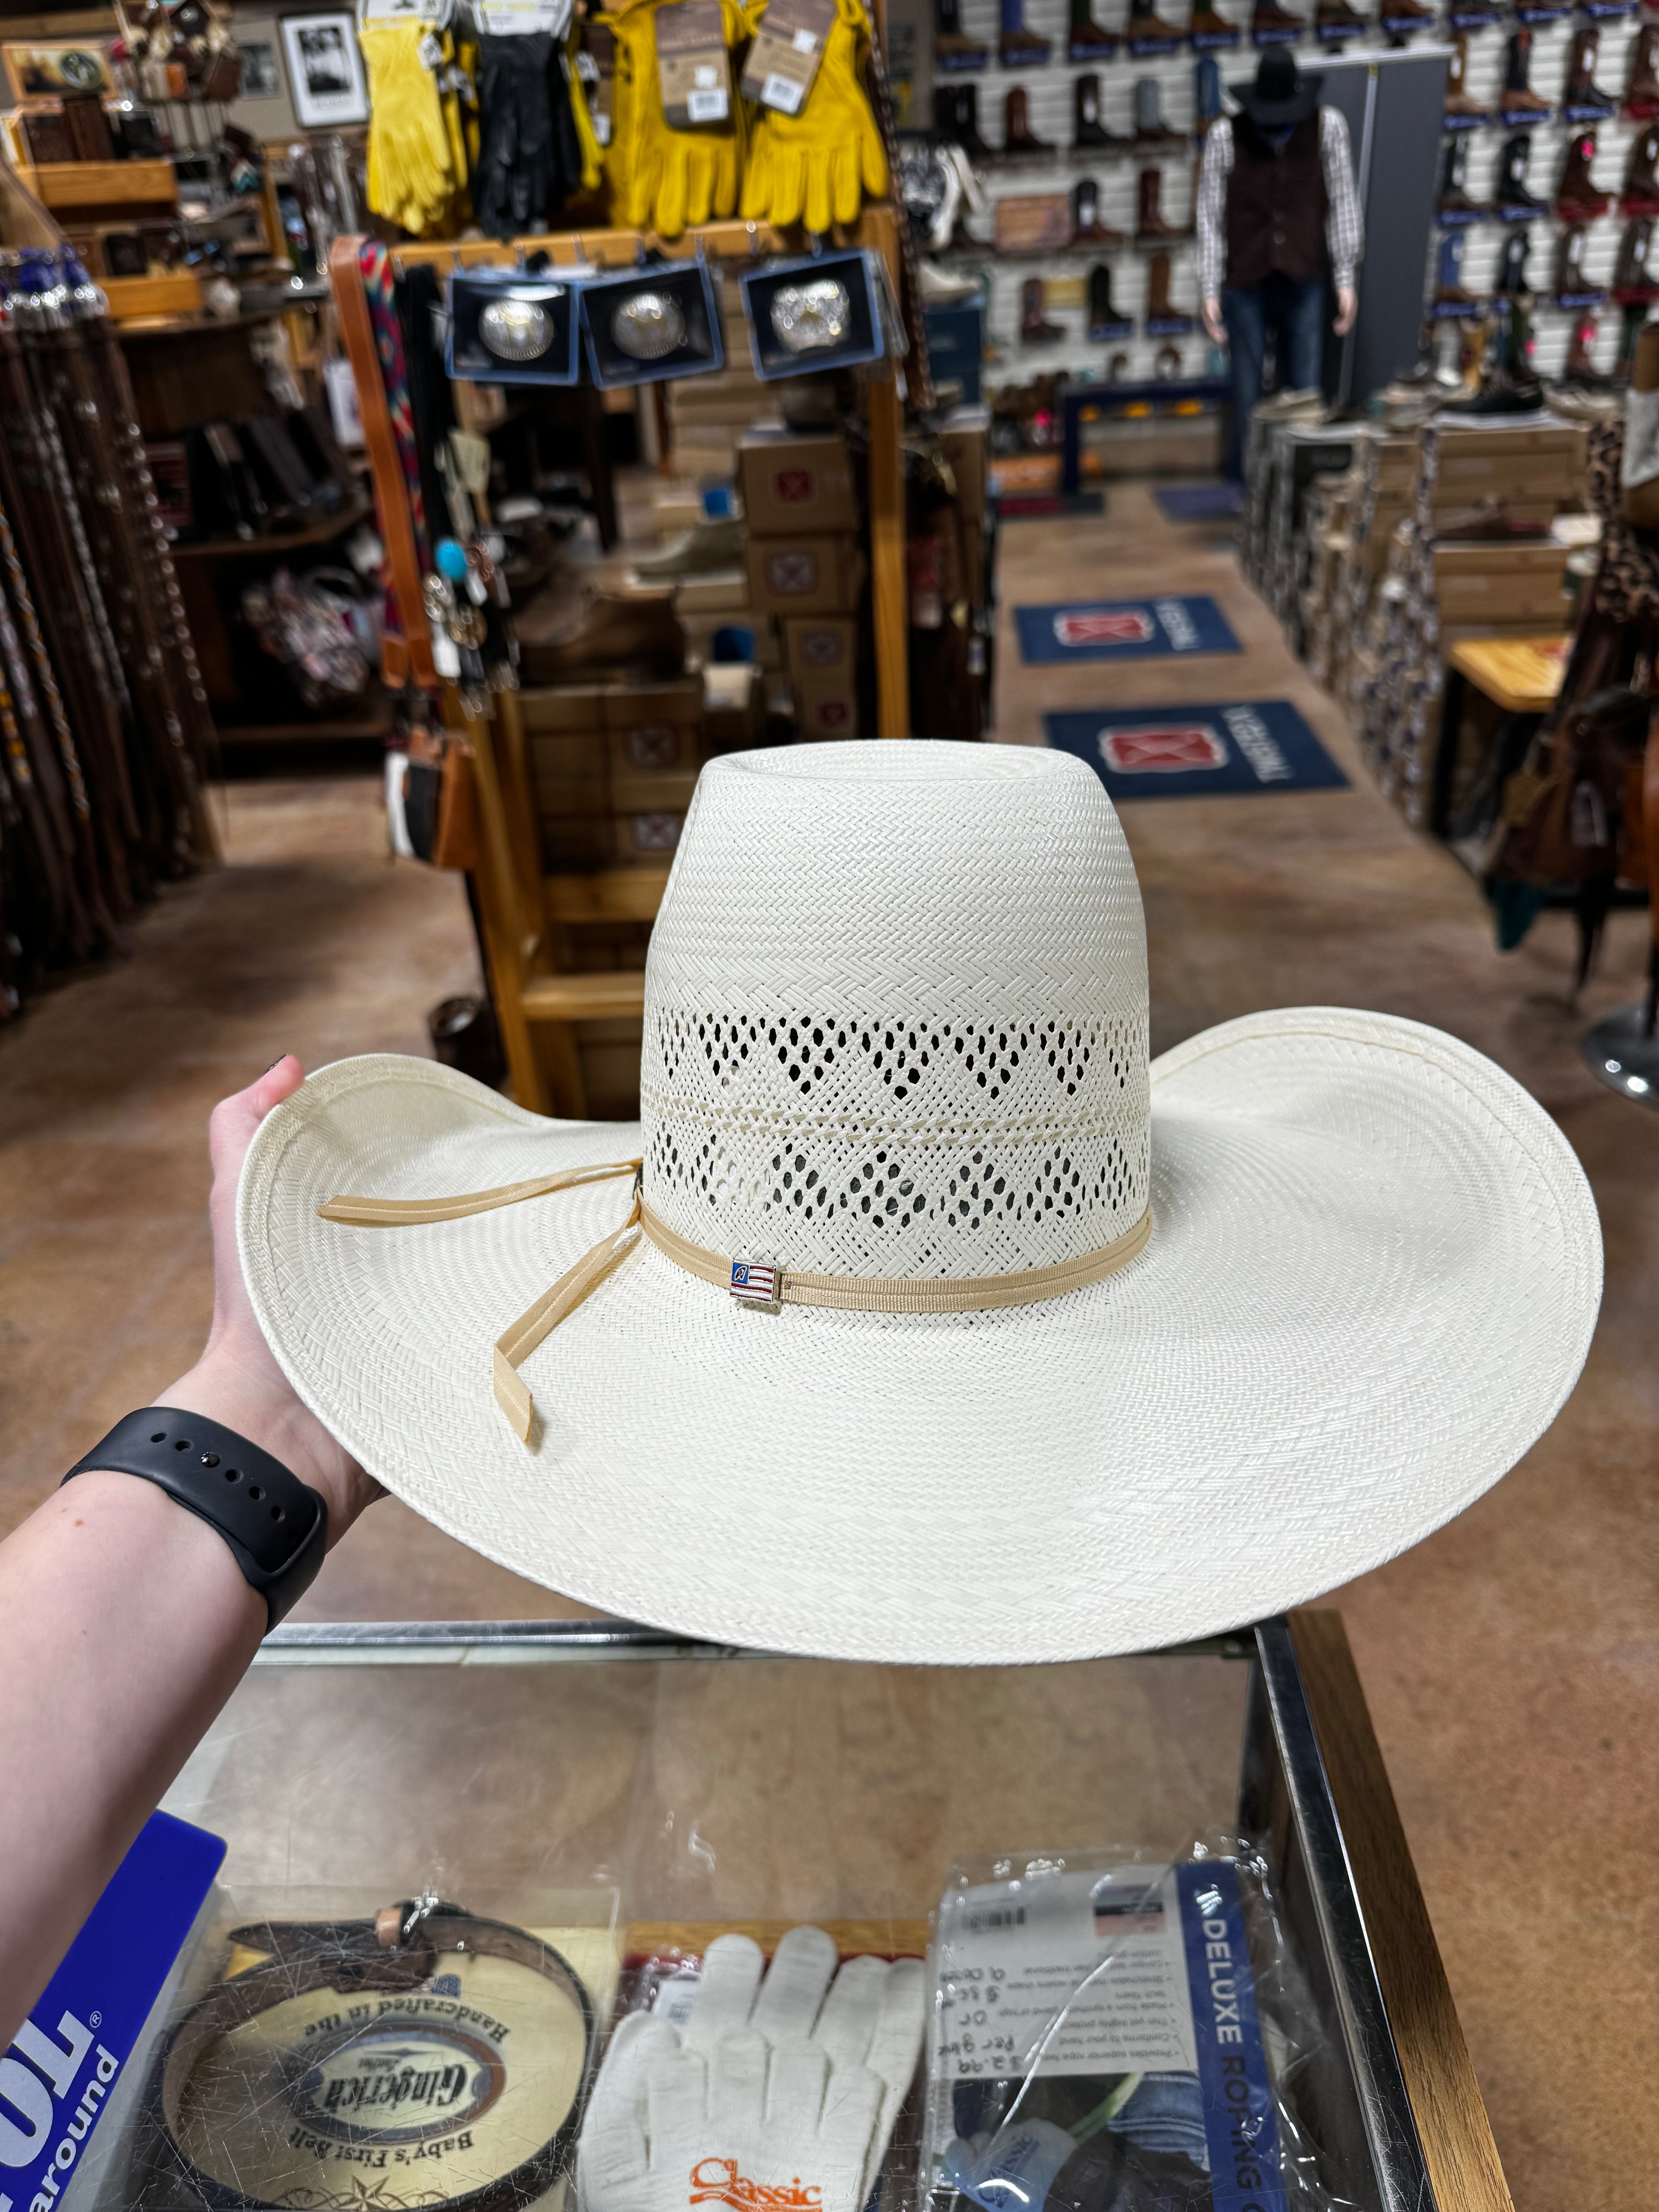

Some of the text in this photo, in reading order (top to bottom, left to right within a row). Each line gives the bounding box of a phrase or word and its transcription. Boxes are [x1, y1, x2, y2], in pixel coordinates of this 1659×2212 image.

[305, 1998, 511, 2044] Handcrafted in the
[1202, 1919, 1243, 2044] DELUXE
[29, 2044, 119, 2212] around
[289, 2126, 474, 2168] Baby's First Belt
[1220, 2055, 1262, 2190] ROPING
[690, 2157, 822, 2204] Classic
